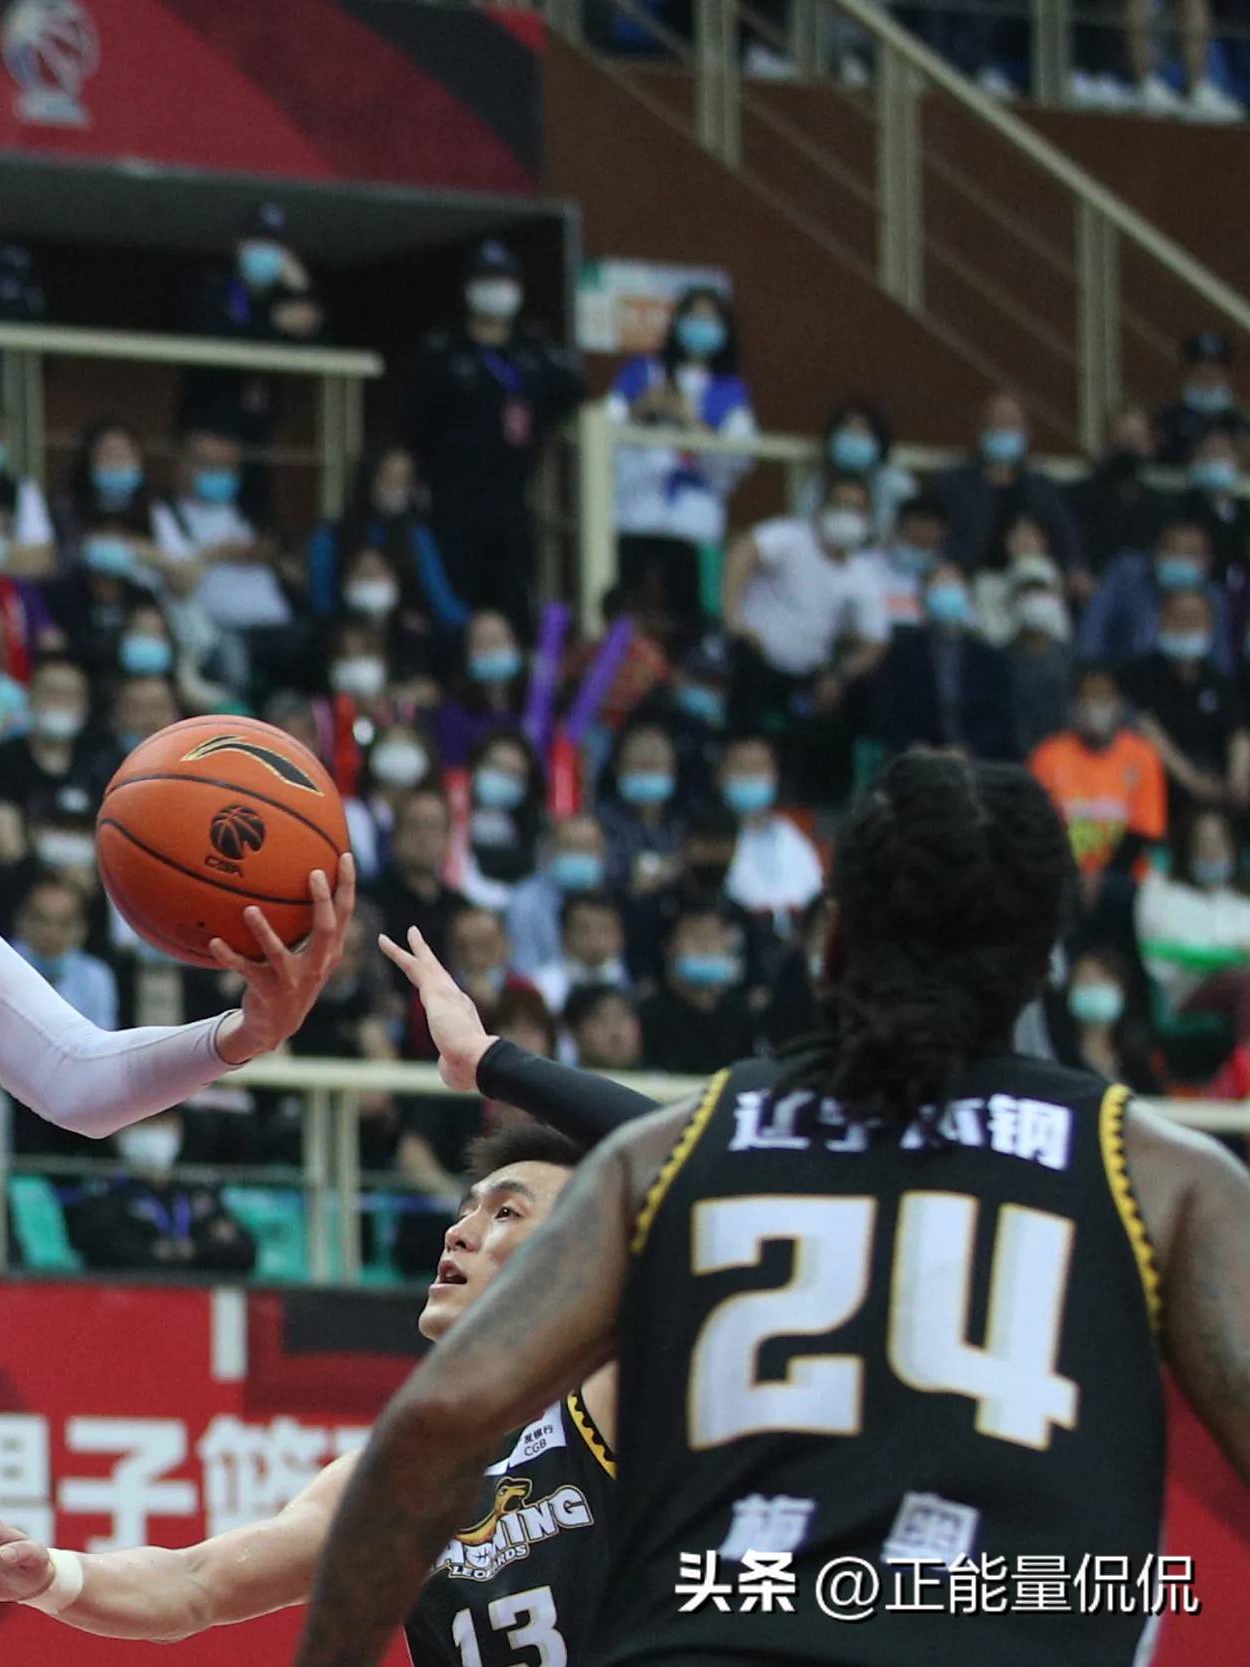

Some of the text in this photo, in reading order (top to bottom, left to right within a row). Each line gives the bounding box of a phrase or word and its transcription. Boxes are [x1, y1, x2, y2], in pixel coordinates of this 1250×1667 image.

[687, 1190, 1080, 1452] 24
[524, 1438, 547, 1456] CGB
[451, 1544, 528, 1579] LEOARDS
[451, 1585, 567, 1667] 13
